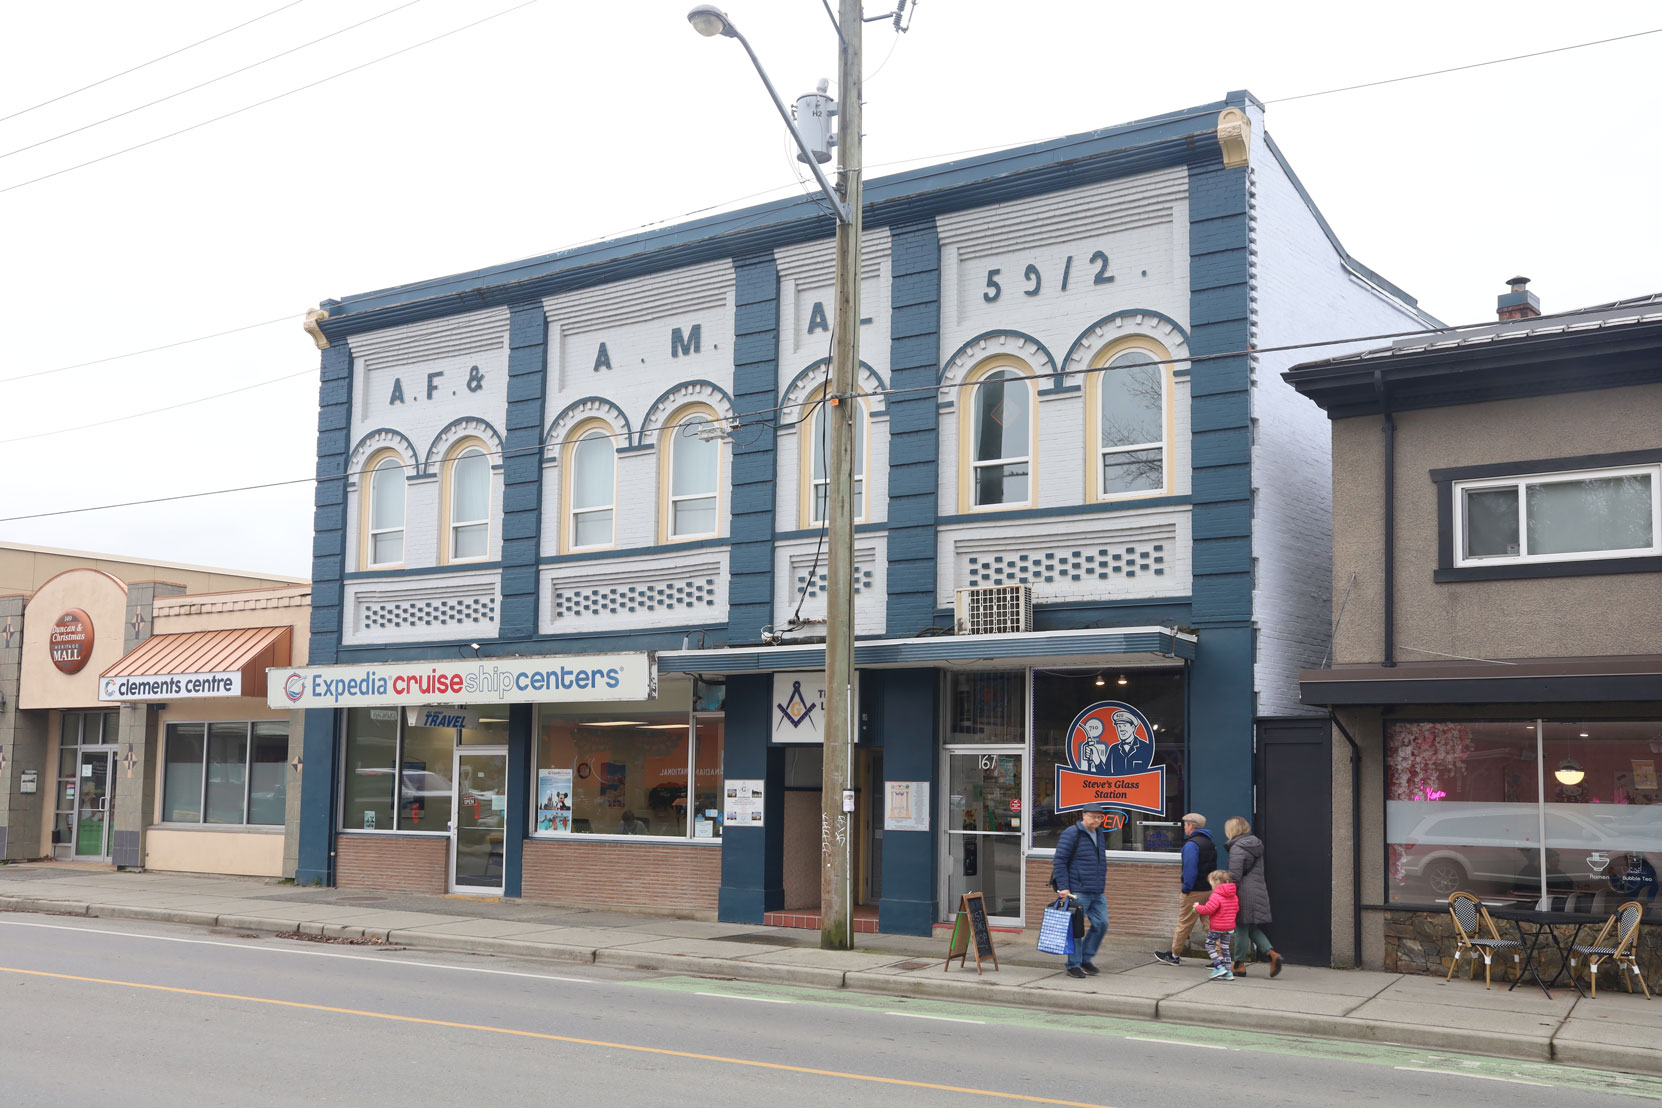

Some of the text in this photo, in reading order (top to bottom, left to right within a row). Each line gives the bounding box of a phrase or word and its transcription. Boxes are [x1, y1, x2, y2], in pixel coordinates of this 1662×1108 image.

[52, 623, 83, 633] Duncan &
[53, 633, 85, 642] Christmas
[53, 649, 80, 661] MALL
[118, 675, 233, 696] clements centre
[423, 714, 467, 728] TRAVEL
[979, 755, 997, 770] 167
[1114, 780, 1140, 789] Glass
[1094, 790, 1127, 799] Station
[1100, 813, 1126, 829] PEN
